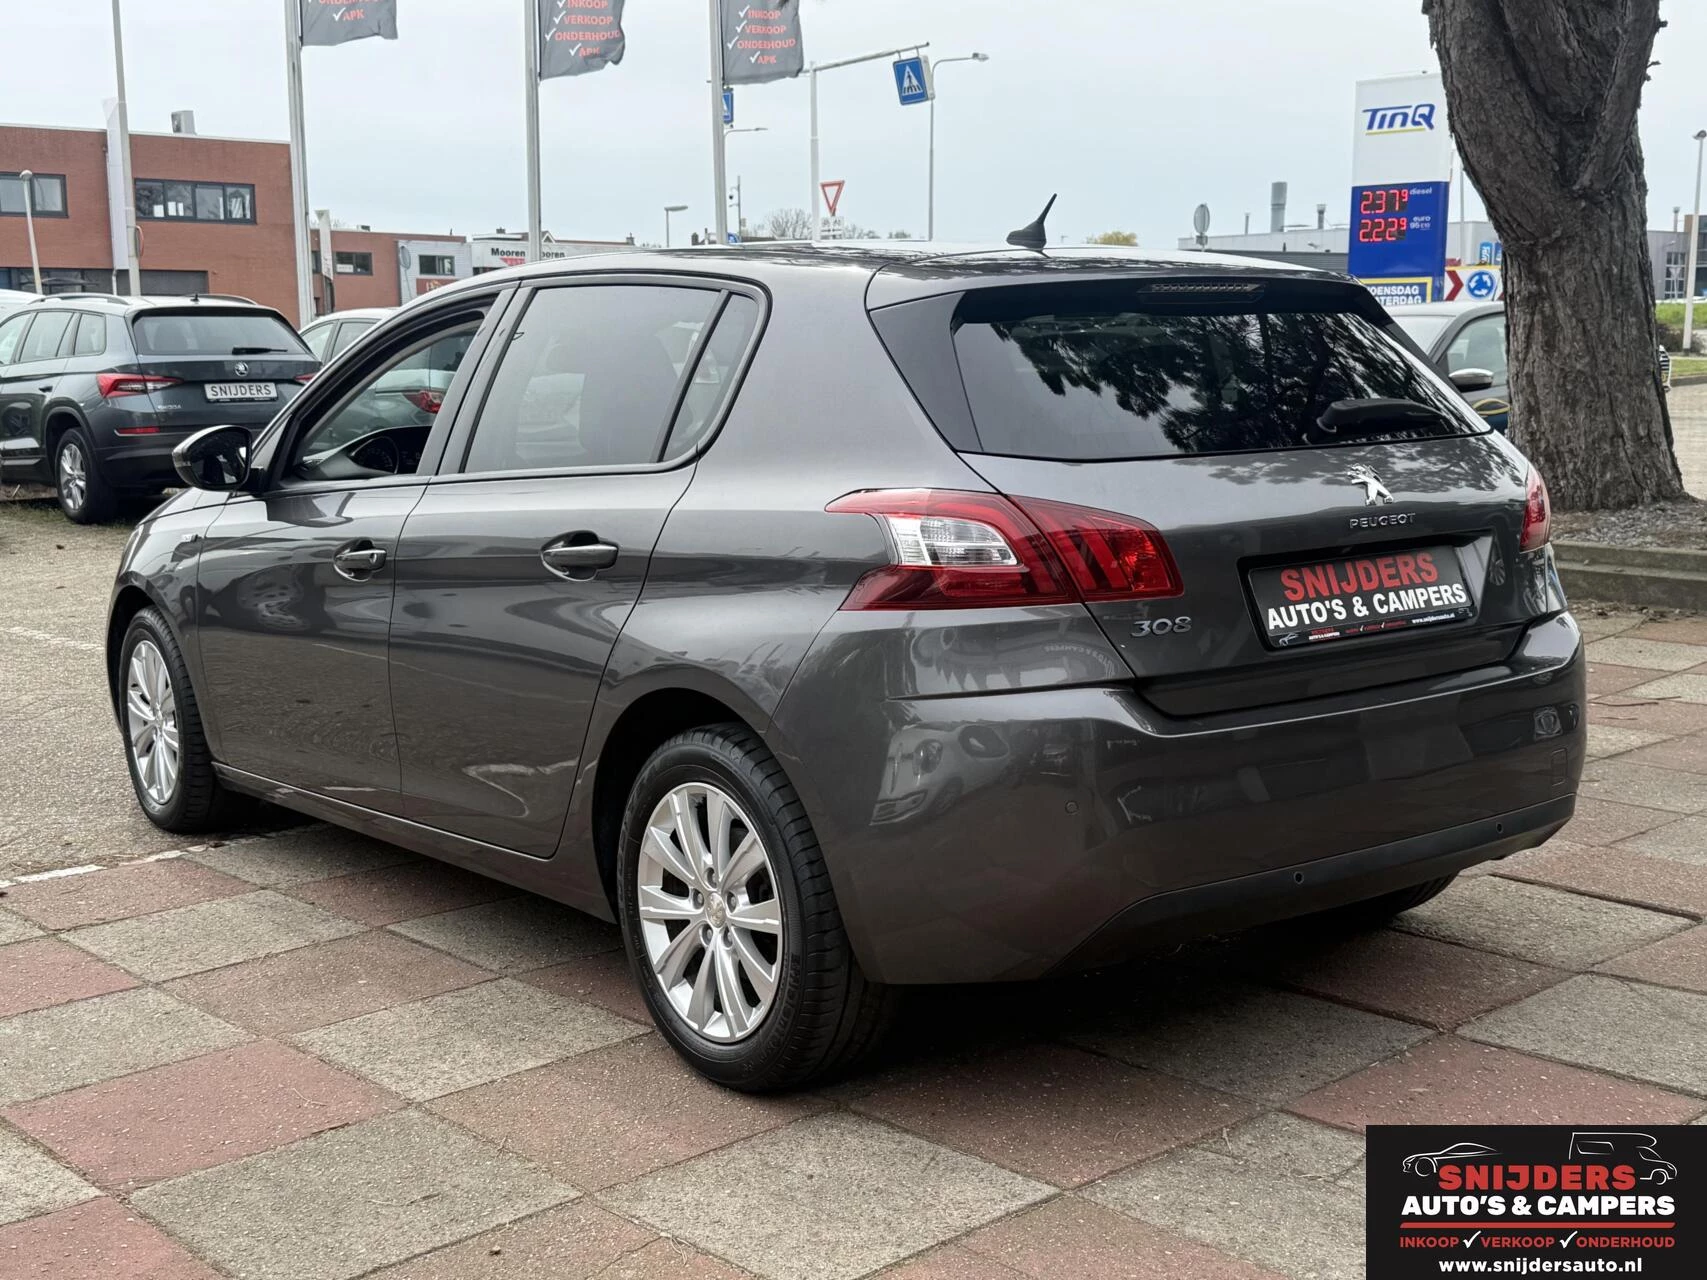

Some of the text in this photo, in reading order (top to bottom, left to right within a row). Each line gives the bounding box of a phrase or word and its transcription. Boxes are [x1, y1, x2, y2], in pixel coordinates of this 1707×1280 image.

[343, 9, 365, 21] APK
[564, 15, 613, 25] VERKOOP
[745, 25, 786, 34] VERKOOP
[555, 30, 620, 41] ONDERHOUD
[737, 38, 796, 49] ONDERHOUD
[579, 47, 600, 57] APK
[758, 55, 776, 64] APK
[1409, 187, 1432, 195] diesel
[491, 248, 525, 257] Mooren
[1367, 286, 1419, 296] OENSDAG
[211, 384, 272, 397] SNIJDERS
[1350, 513, 1416, 528] PEUGEOT
[1280, 552, 1438, 601] SNIJDERS
[1268, 583, 1467, 630] AUTO'S & CAMPERS
[1131, 616, 1192, 637] 308
